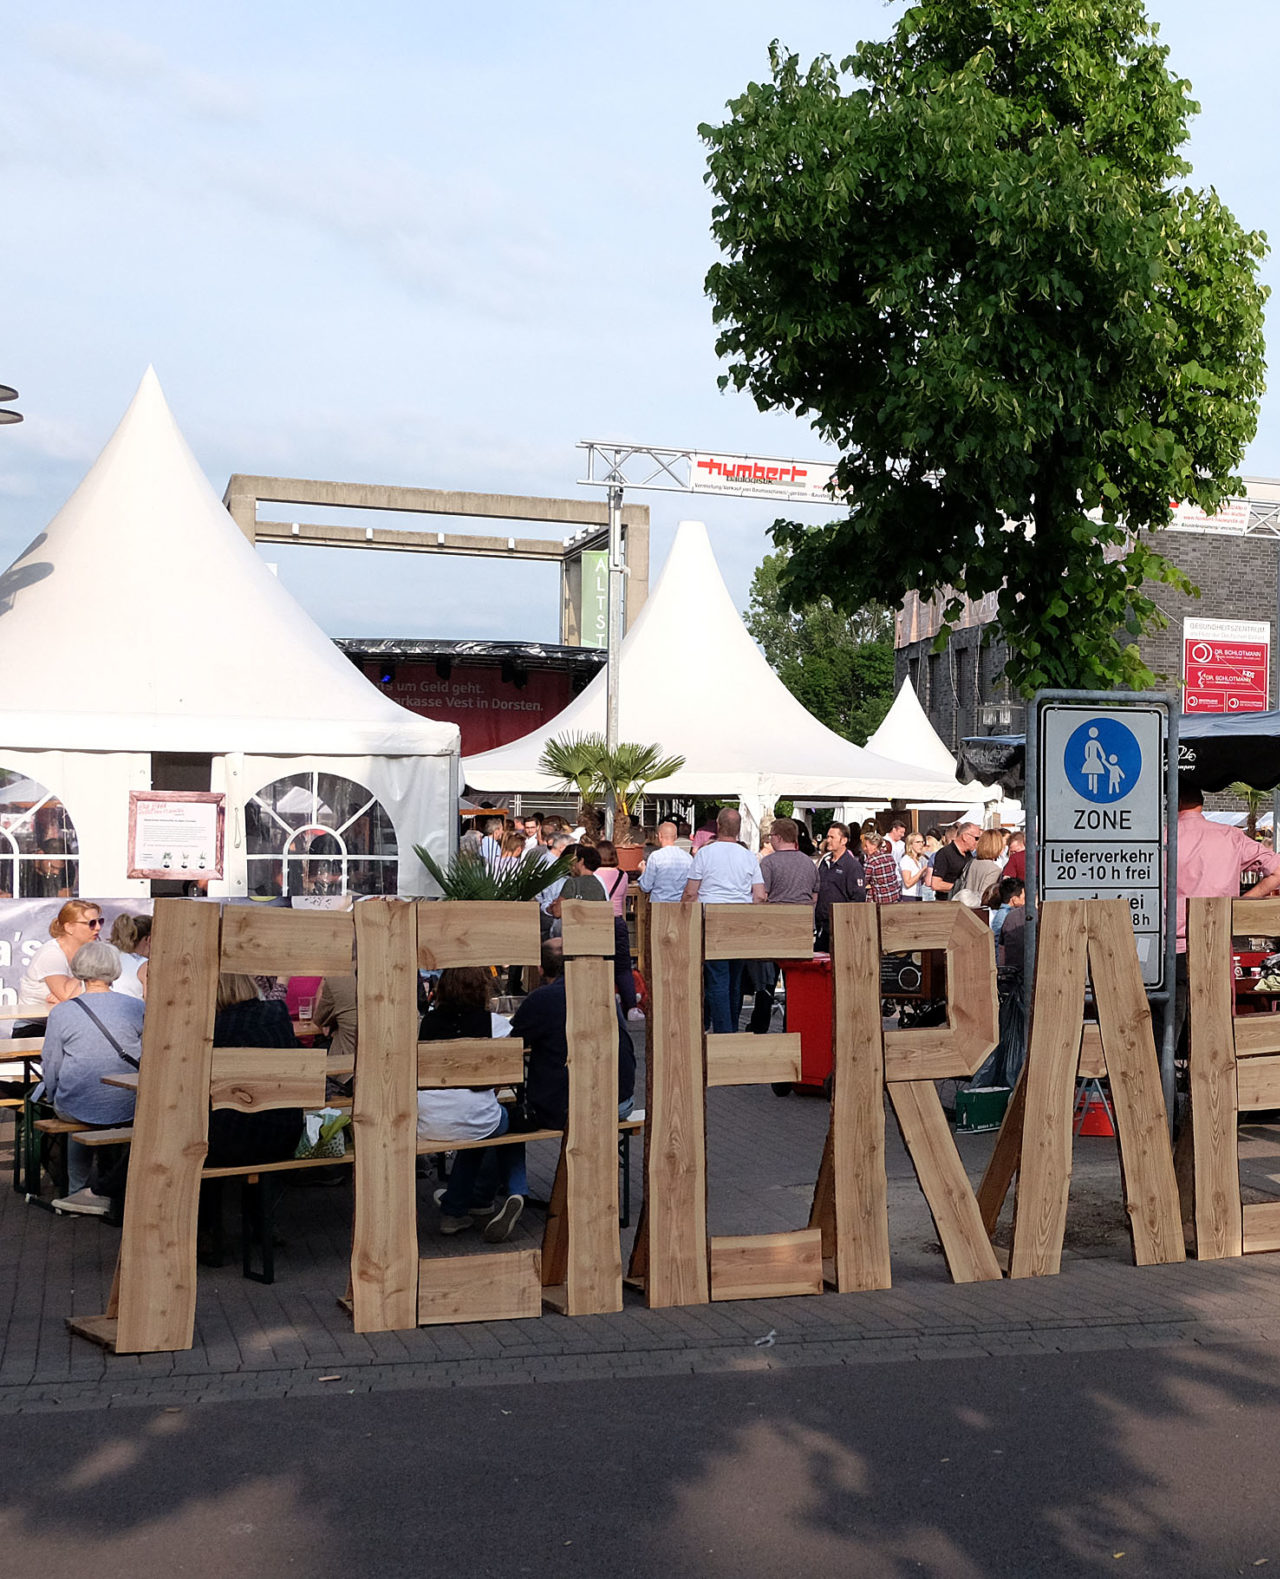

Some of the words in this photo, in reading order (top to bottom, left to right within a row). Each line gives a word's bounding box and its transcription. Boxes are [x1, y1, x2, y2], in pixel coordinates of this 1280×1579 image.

[697, 458, 807, 482] humbert
[1224, 649, 1262, 657] SCHLOTMANN
[397, 683, 416, 692] um
[420, 680, 449, 693] Geld
[452, 681, 485, 696] geht.
[445, 696, 473, 708] Vest
[477, 697, 488, 708] in
[491, 698, 544, 711] Dorsten.
[1073, 810, 1132, 830] ZONE
[1051, 848, 1155, 864] Lieferverkehr
[1057, 866, 1077, 880] 20
[1111, 866, 1120, 880] h
[1125, 866, 1151, 880] frei
[1143, 913, 1150, 925] h
